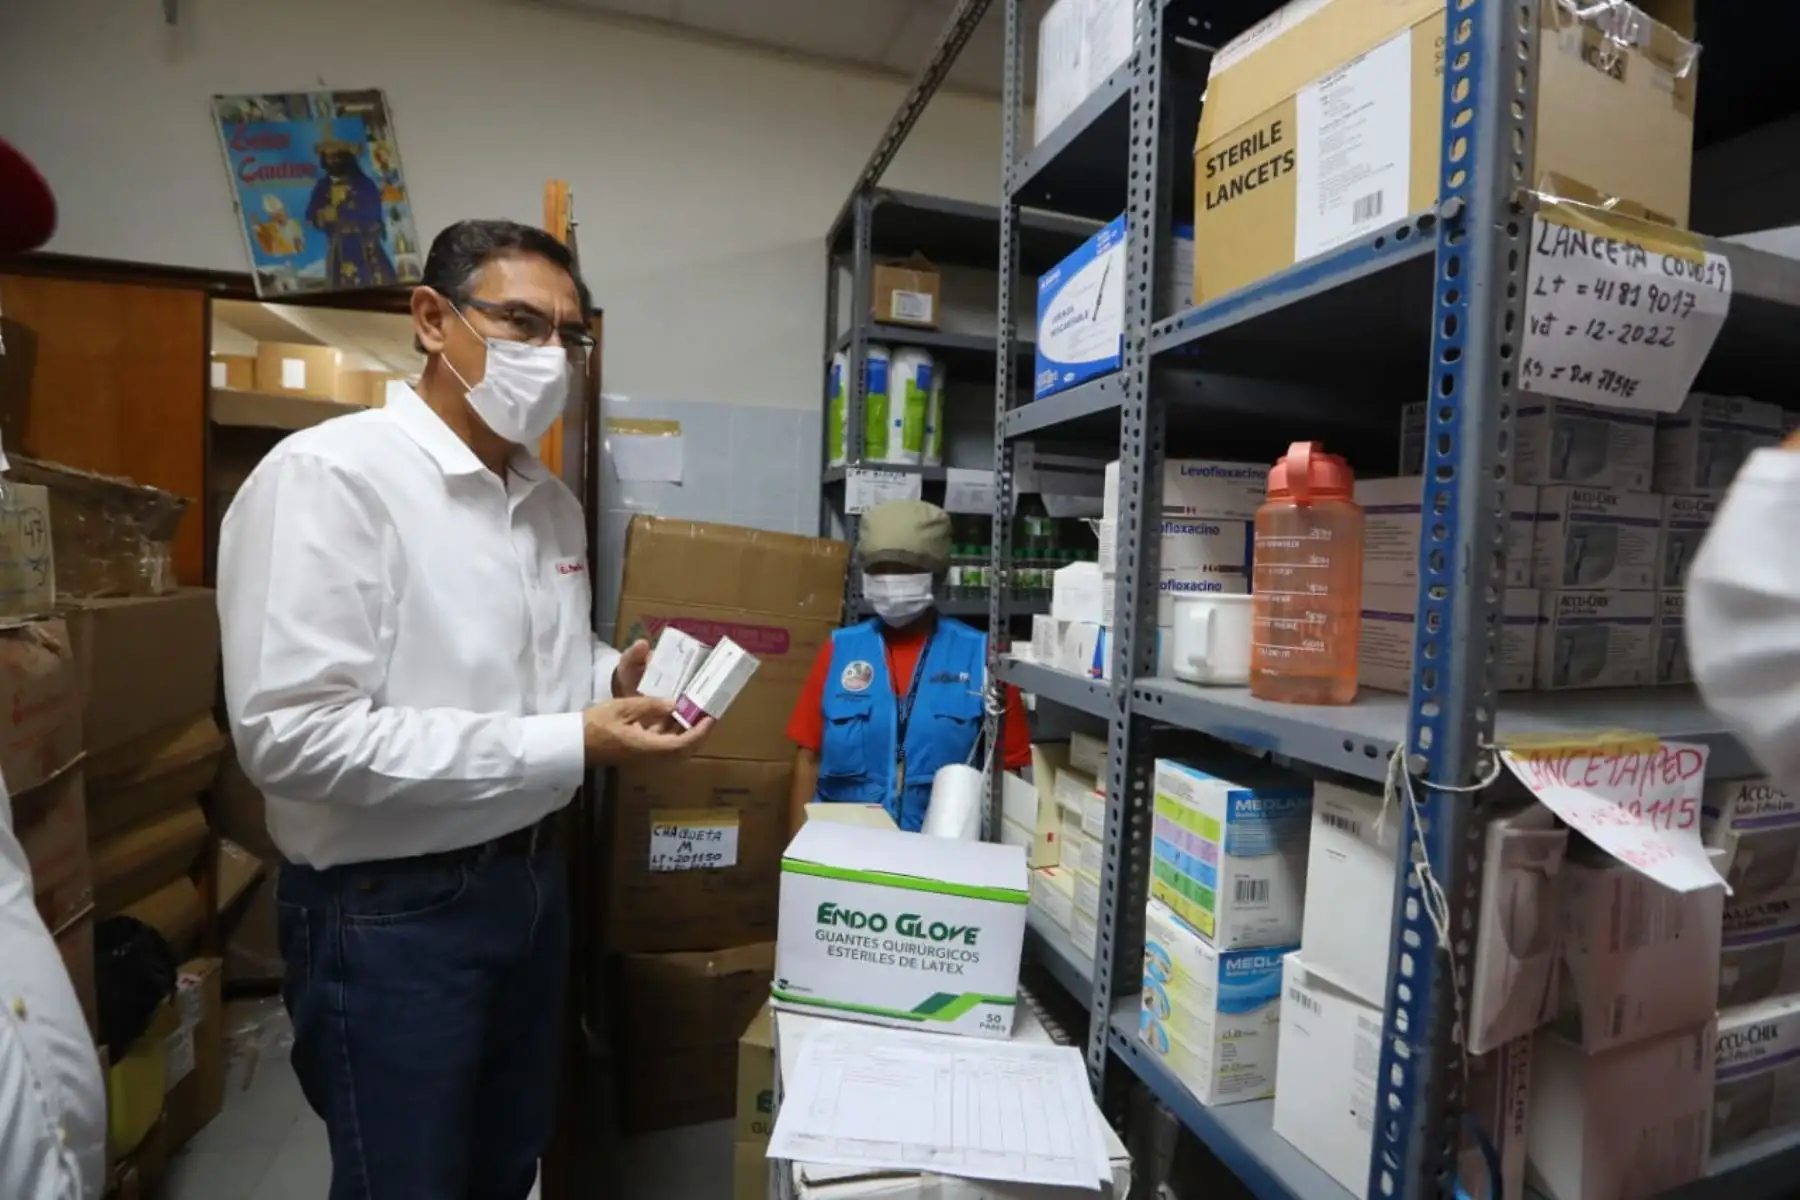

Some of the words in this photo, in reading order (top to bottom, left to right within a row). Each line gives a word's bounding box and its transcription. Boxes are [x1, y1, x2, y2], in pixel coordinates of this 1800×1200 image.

[1205, 120, 1283, 179] STERILE
[1206, 148, 1295, 211] LANCETS
[1180, 464, 1267, 480] Levofloxacino
[1159, 522, 1220, 535] ofloxacino
[1160, 578, 1222, 592] ofloxacino
[677, 841, 692, 853] M
[816, 902, 888, 933] ENDO
[895, 913, 980, 945] GLOVE
[815, 929, 879, 949] GUANTES
[882, 940, 980, 963] QUIRÚRGICOS
[899, 956, 917, 969] DE
[921, 961, 964, 975] LATEX
[986, 1014, 1002, 1024] 50
